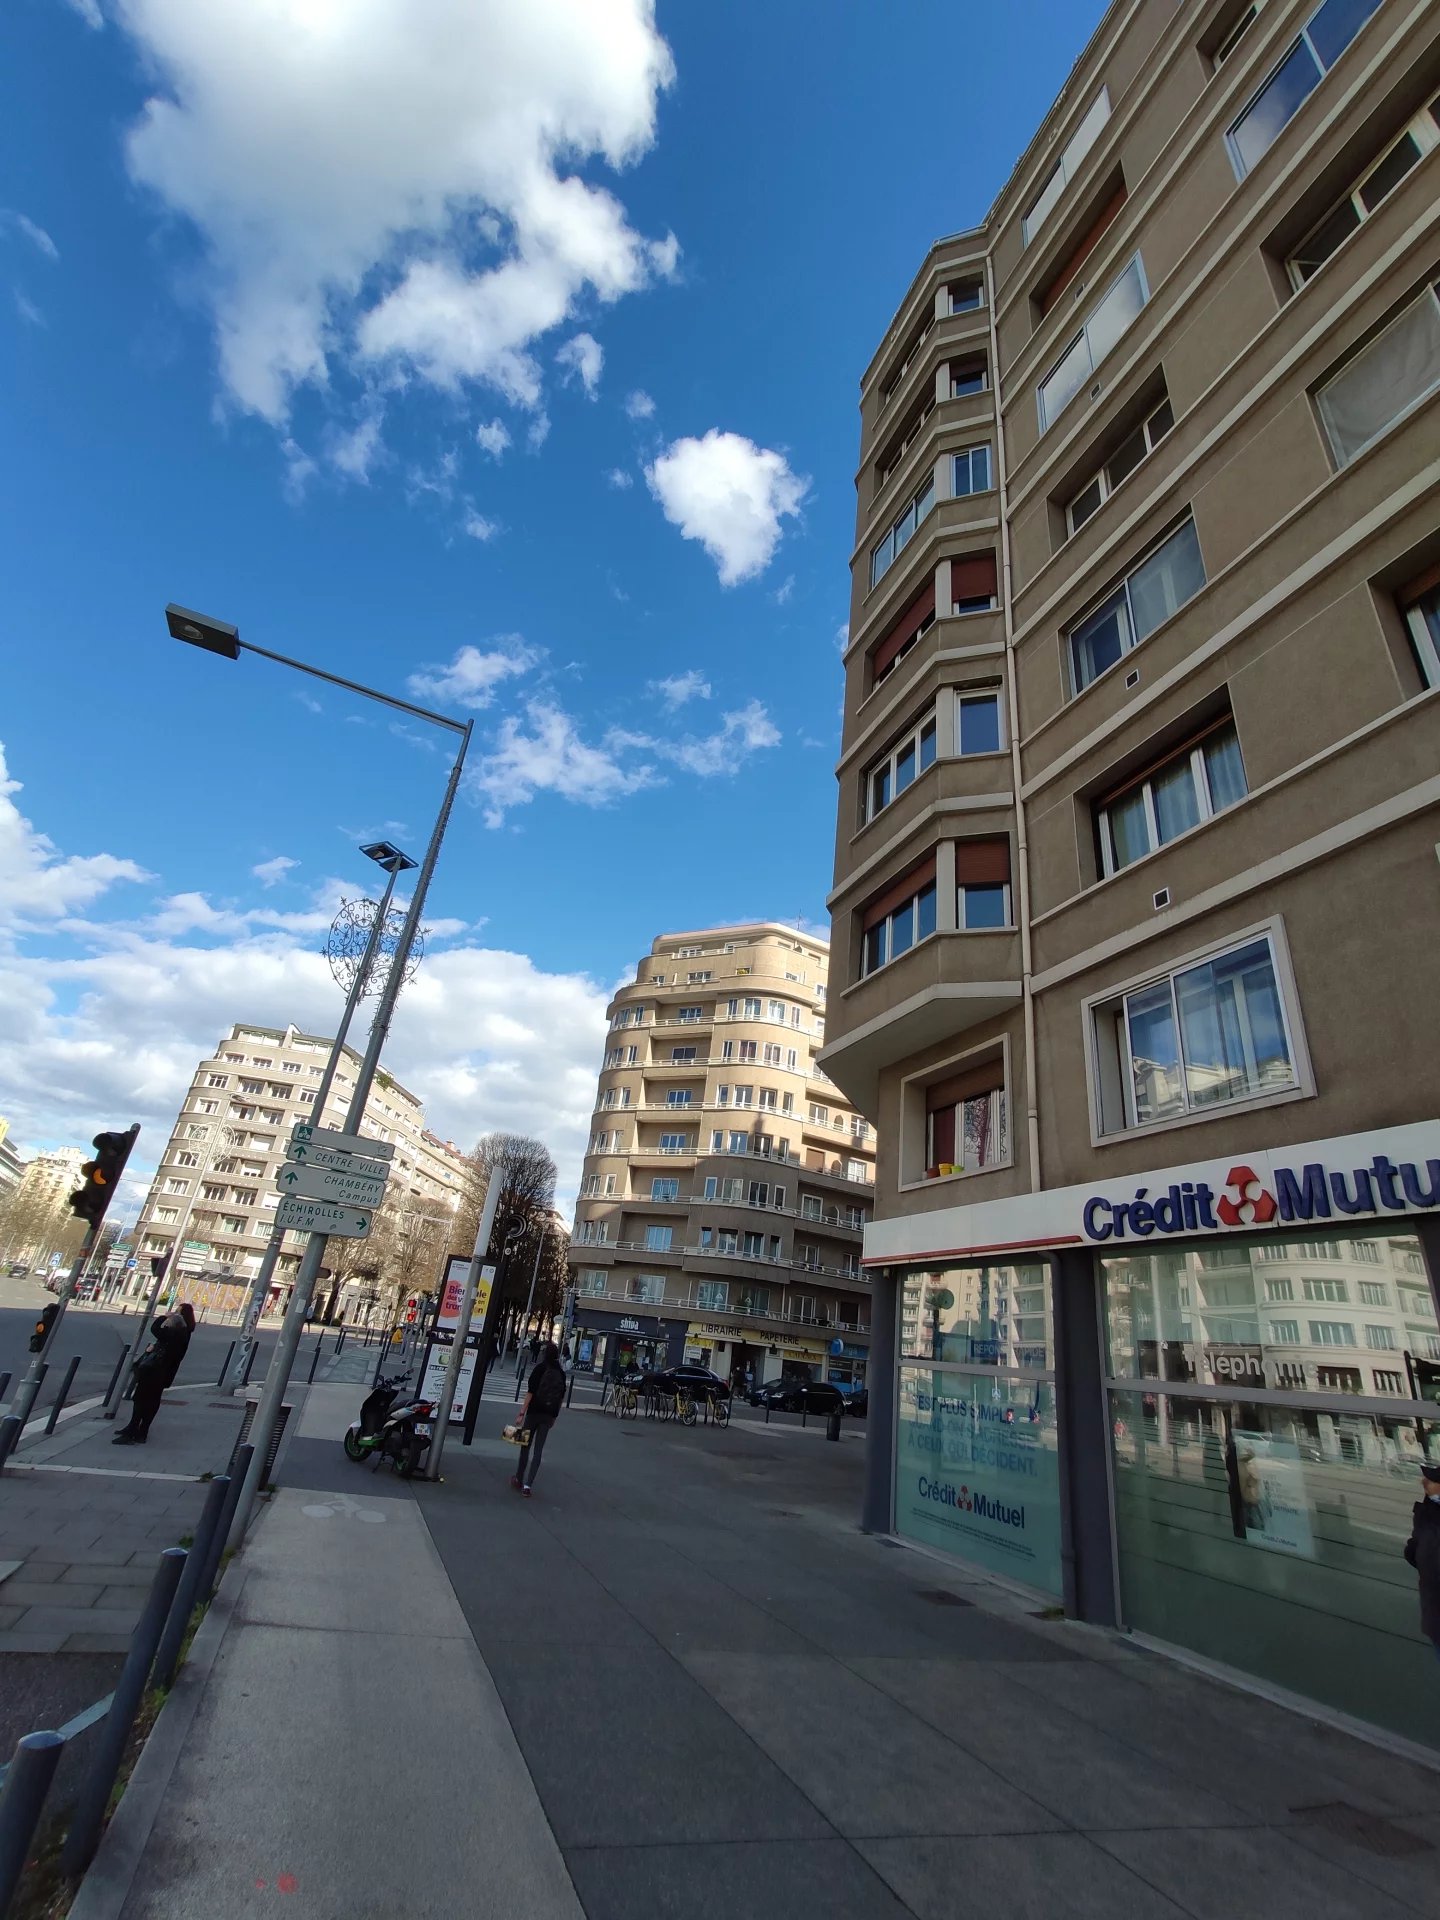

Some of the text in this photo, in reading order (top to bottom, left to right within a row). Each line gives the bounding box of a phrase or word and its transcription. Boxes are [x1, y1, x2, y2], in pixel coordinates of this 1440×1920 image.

[315, 1152, 385, 1175] CENTRE VILLE
[324, 1175, 381, 1193] CHAMBÉRY
[338, 1189, 378, 1204] Campus
[282, 1201, 345, 1219] ÉCHIROLLES
[1083, 1183, 1218, 1241] Crédit
[700, 1323, 800, 1345] LIBRAIRIE PAPETERIE
[939, 1399, 968, 1417] PLUS
[918, 1476, 1025, 1529] Crédit Mutuel
